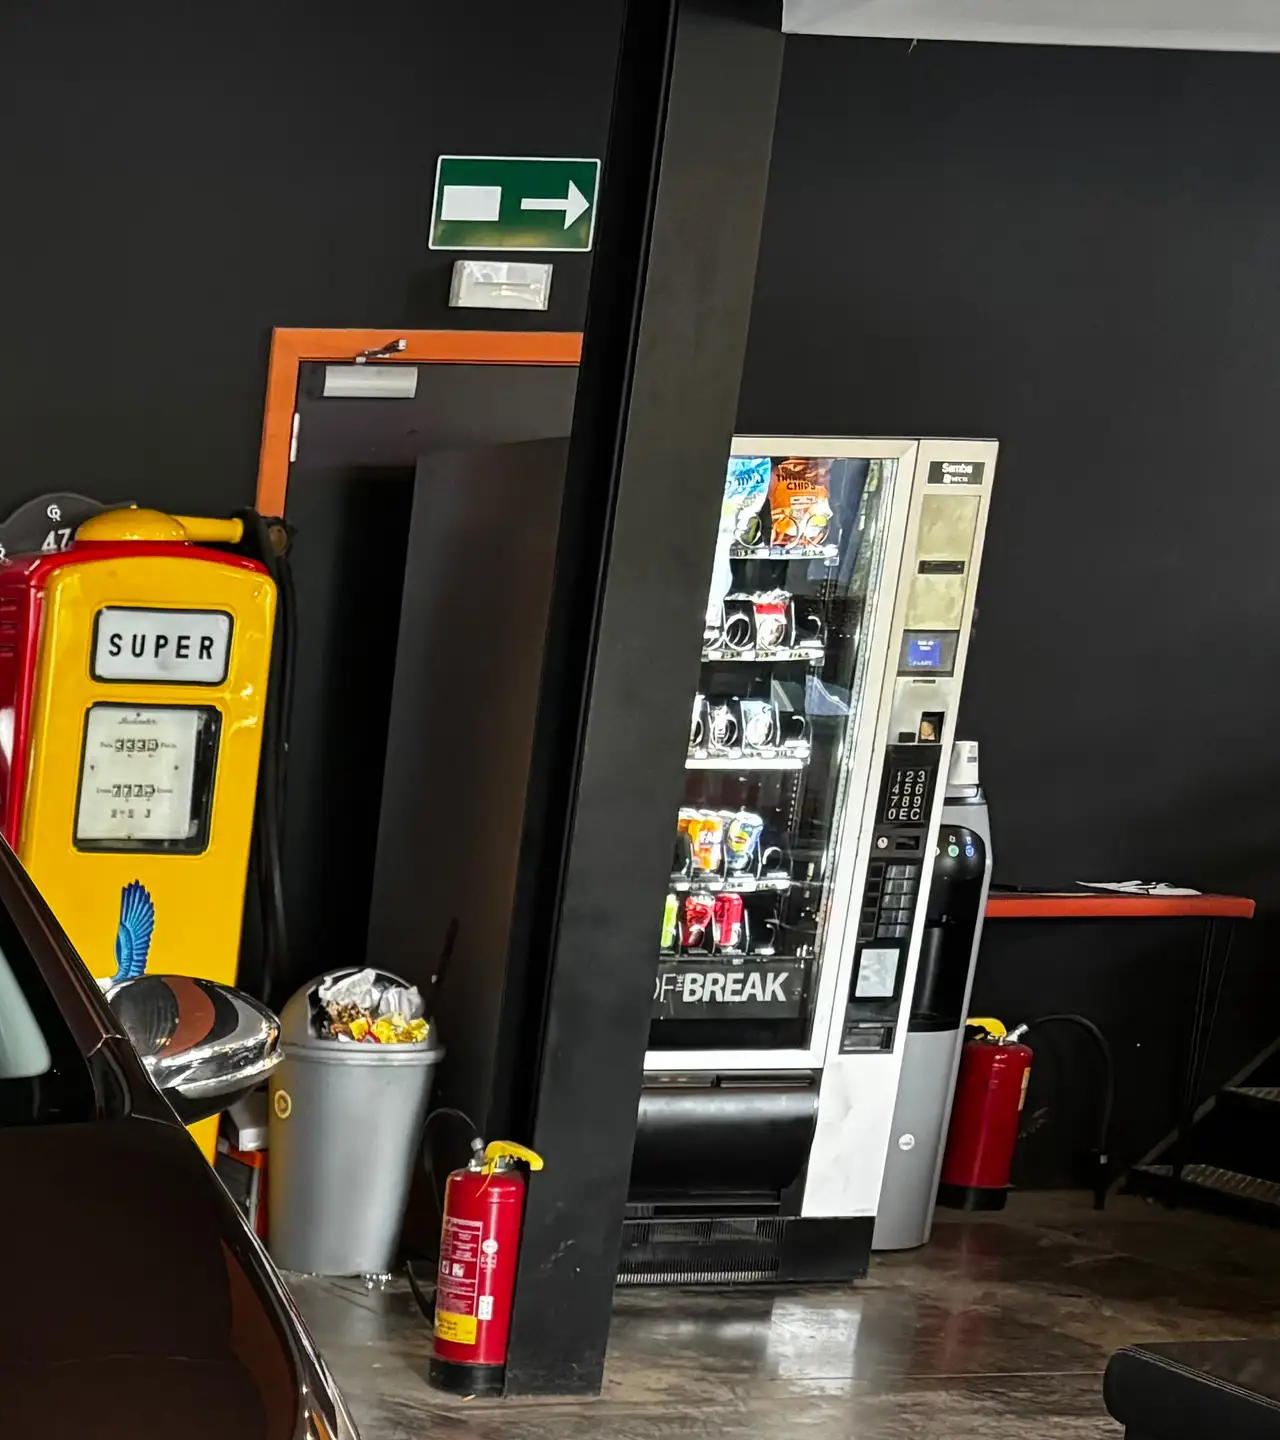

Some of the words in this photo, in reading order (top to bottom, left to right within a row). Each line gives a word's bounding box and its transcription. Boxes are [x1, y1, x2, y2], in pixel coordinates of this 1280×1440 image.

[108, 633, 214, 660] SUPER
[897, 771, 901, 782] 1
[905, 771, 914, 782] 2
[917, 770, 925, 782] 3
[892, 784, 899, 794] 4
[904, 783, 911, 794] 5
[915, 783, 923, 794] 6
[890, 796, 899, 807] 7
[901, 796, 909, 807] 8
[913, 796, 921, 807] 9
[899, 808, 908, 819] E
[910, 808, 920, 820] C
[682, 972, 789, 1002] BREAK
